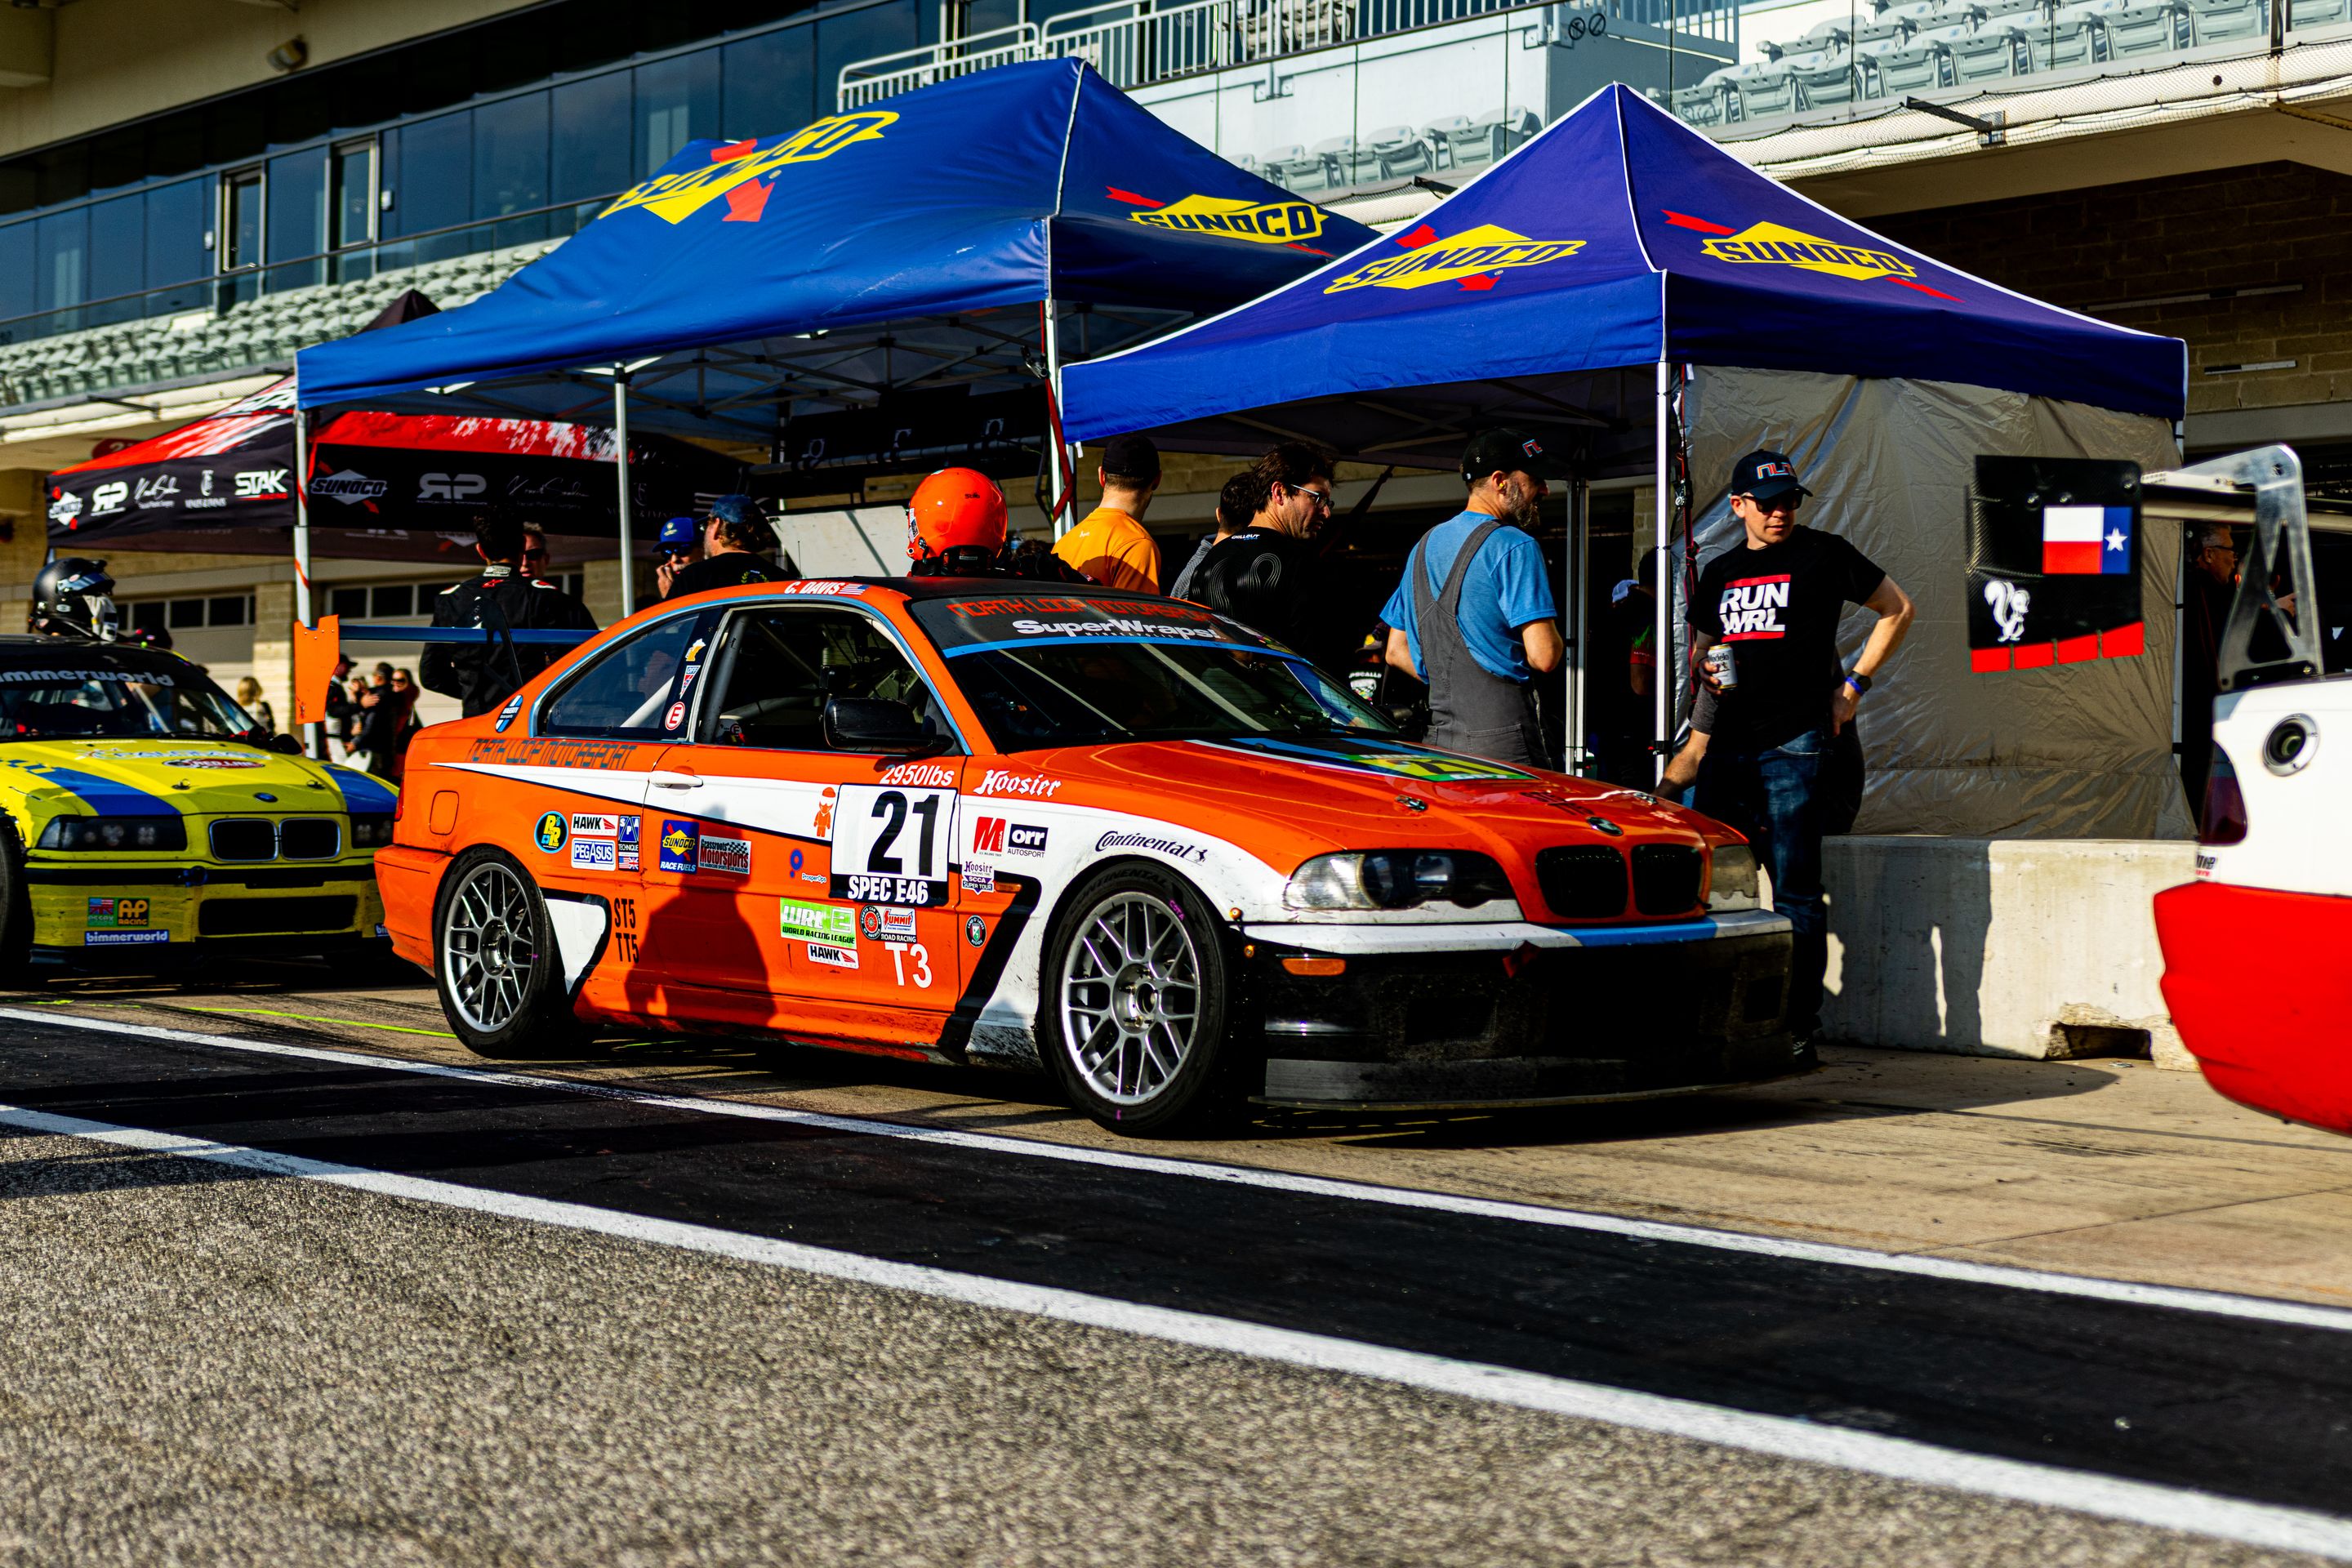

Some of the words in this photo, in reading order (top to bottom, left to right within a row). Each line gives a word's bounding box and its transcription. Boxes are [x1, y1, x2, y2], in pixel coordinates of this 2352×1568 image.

[1138, 206, 1316, 237] SUNOCO
[1332, 244, 1576, 290] SUNOCO
[1712, 242, 1909, 273] SUNOCO
[235, 470, 287, 495] STAK
[313, 479, 385, 496] SUNOCO
[800, 581, 845, 595] DAVIS
[1719, 582, 1790, 614] RUN
[946, 598, 1025, 619] NORTH
[1031, 599, 1087, 612] LOOP
[1012, 619, 1220, 640] SuperWraps!
[1720, 608, 1786, 635] WRL
[670, 706, 682, 724] E
[539, 741, 638, 771] MOTORSPORT
[880, 764, 955, 786] 2950lbs
[973, 769, 1062, 797] Hoosier
[572, 816, 602, 830] HAWK
[867, 791, 939, 876] 21
[664, 837, 695, 849] SUNOCO
[701, 839, 728, 852] Grassroots
[1012, 829, 1045, 846] orr
[1094, 831, 1196, 859] Continental
[574, 841, 613, 862] PEGASUS
[700, 848, 750, 869] Motorsports
[1007, 848, 1045, 858] AUTOSPORT
[660, 861, 678, 870] RACE
[677, 862, 697, 872] FUELS
[964, 861, 993, 873] Hoosier
[848, 875, 891, 902] SPEC
[894, 879, 929, 905] E46
[969, 875, 987, 884] SCCA
[614, 898, 636, 929] ST5
[86, 931, 168, 942] bimmerworld
[782, 925, 805, 936] WORLD
[805, 929, 831, 940] RACING
[831, 933, 855, 945] LEAGUE
[881, 933, 896, 941] ROAD
[896, 934, 916, 943] RACING
[615, 933, 639, 963] TT5
[809, 945, 841, 962] HAWK
[884, 942, 933, 988] T3
